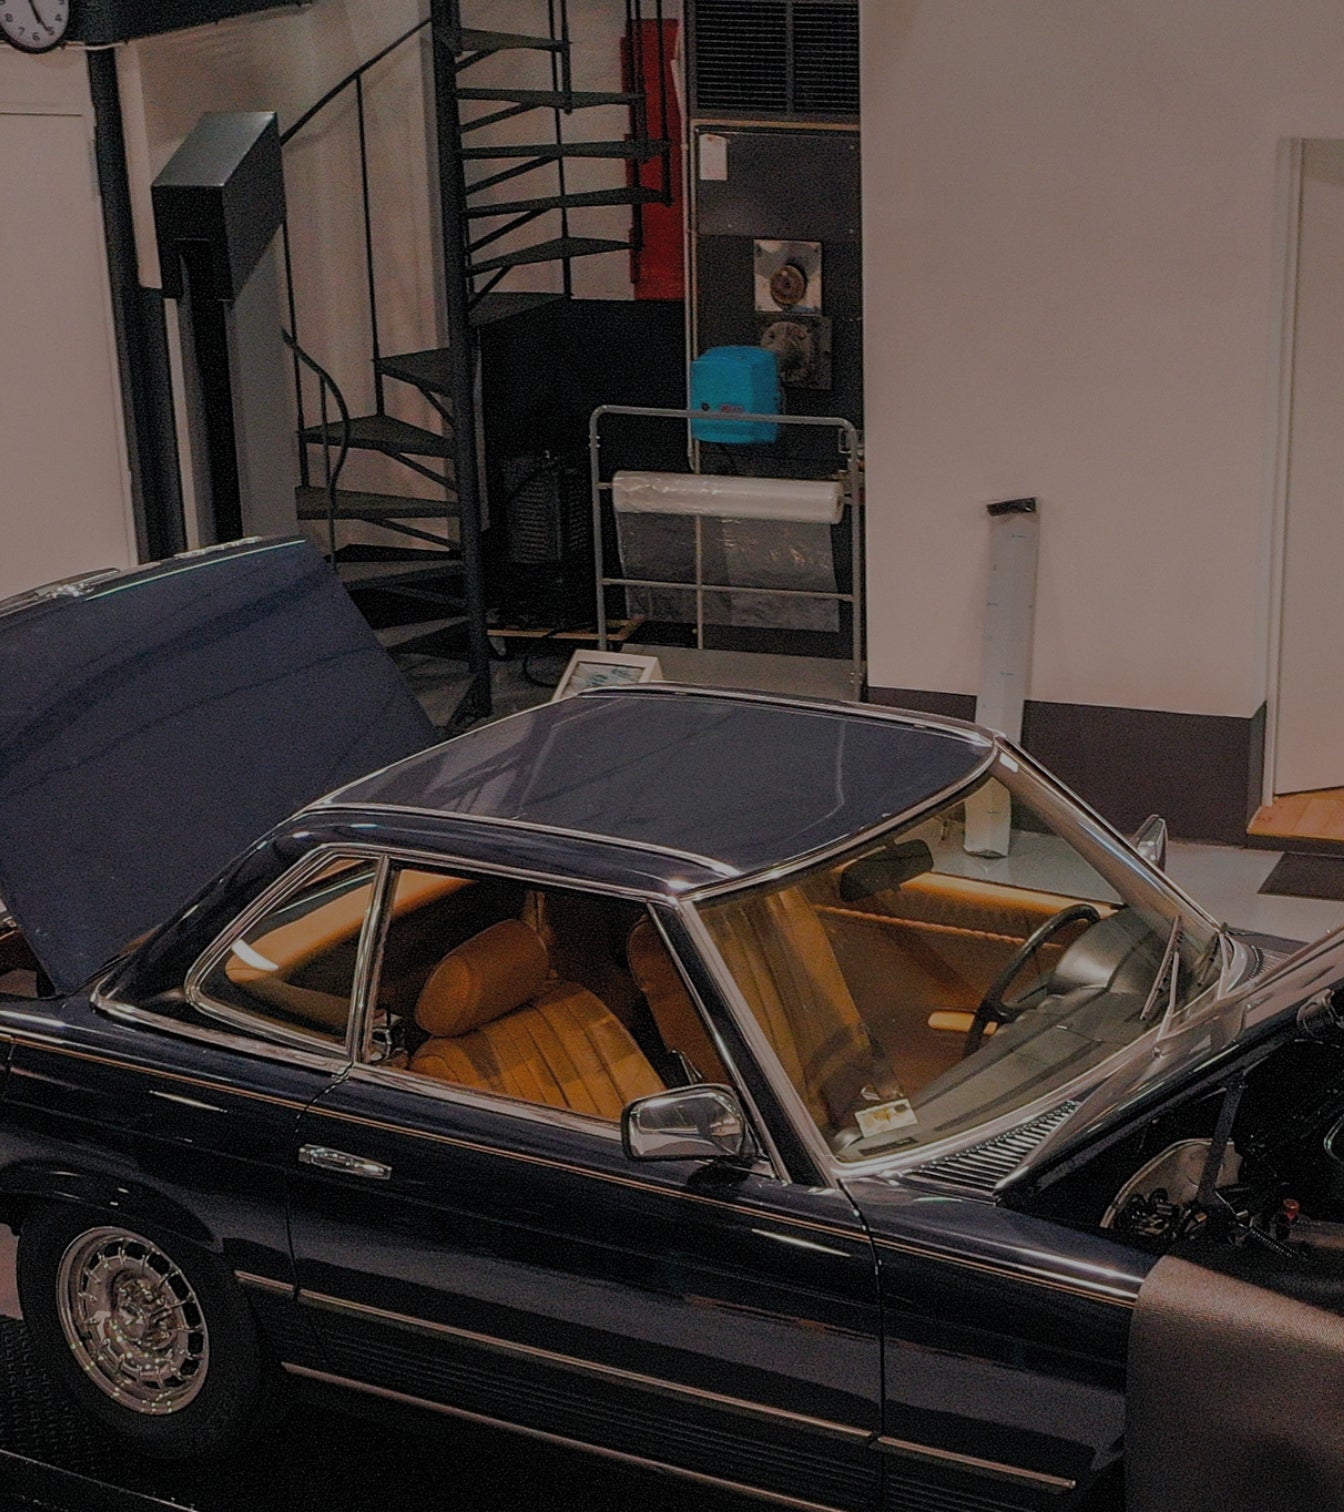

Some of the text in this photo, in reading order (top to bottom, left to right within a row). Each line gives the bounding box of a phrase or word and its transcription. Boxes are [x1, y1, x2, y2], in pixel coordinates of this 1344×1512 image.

[5, 13, 13, 22] 8
[55, 14, 62, 22] 4
[18, 26, 25, 35] 7
[47, 26, 55, 36] 5
[32, 32, 40, 41] 6
